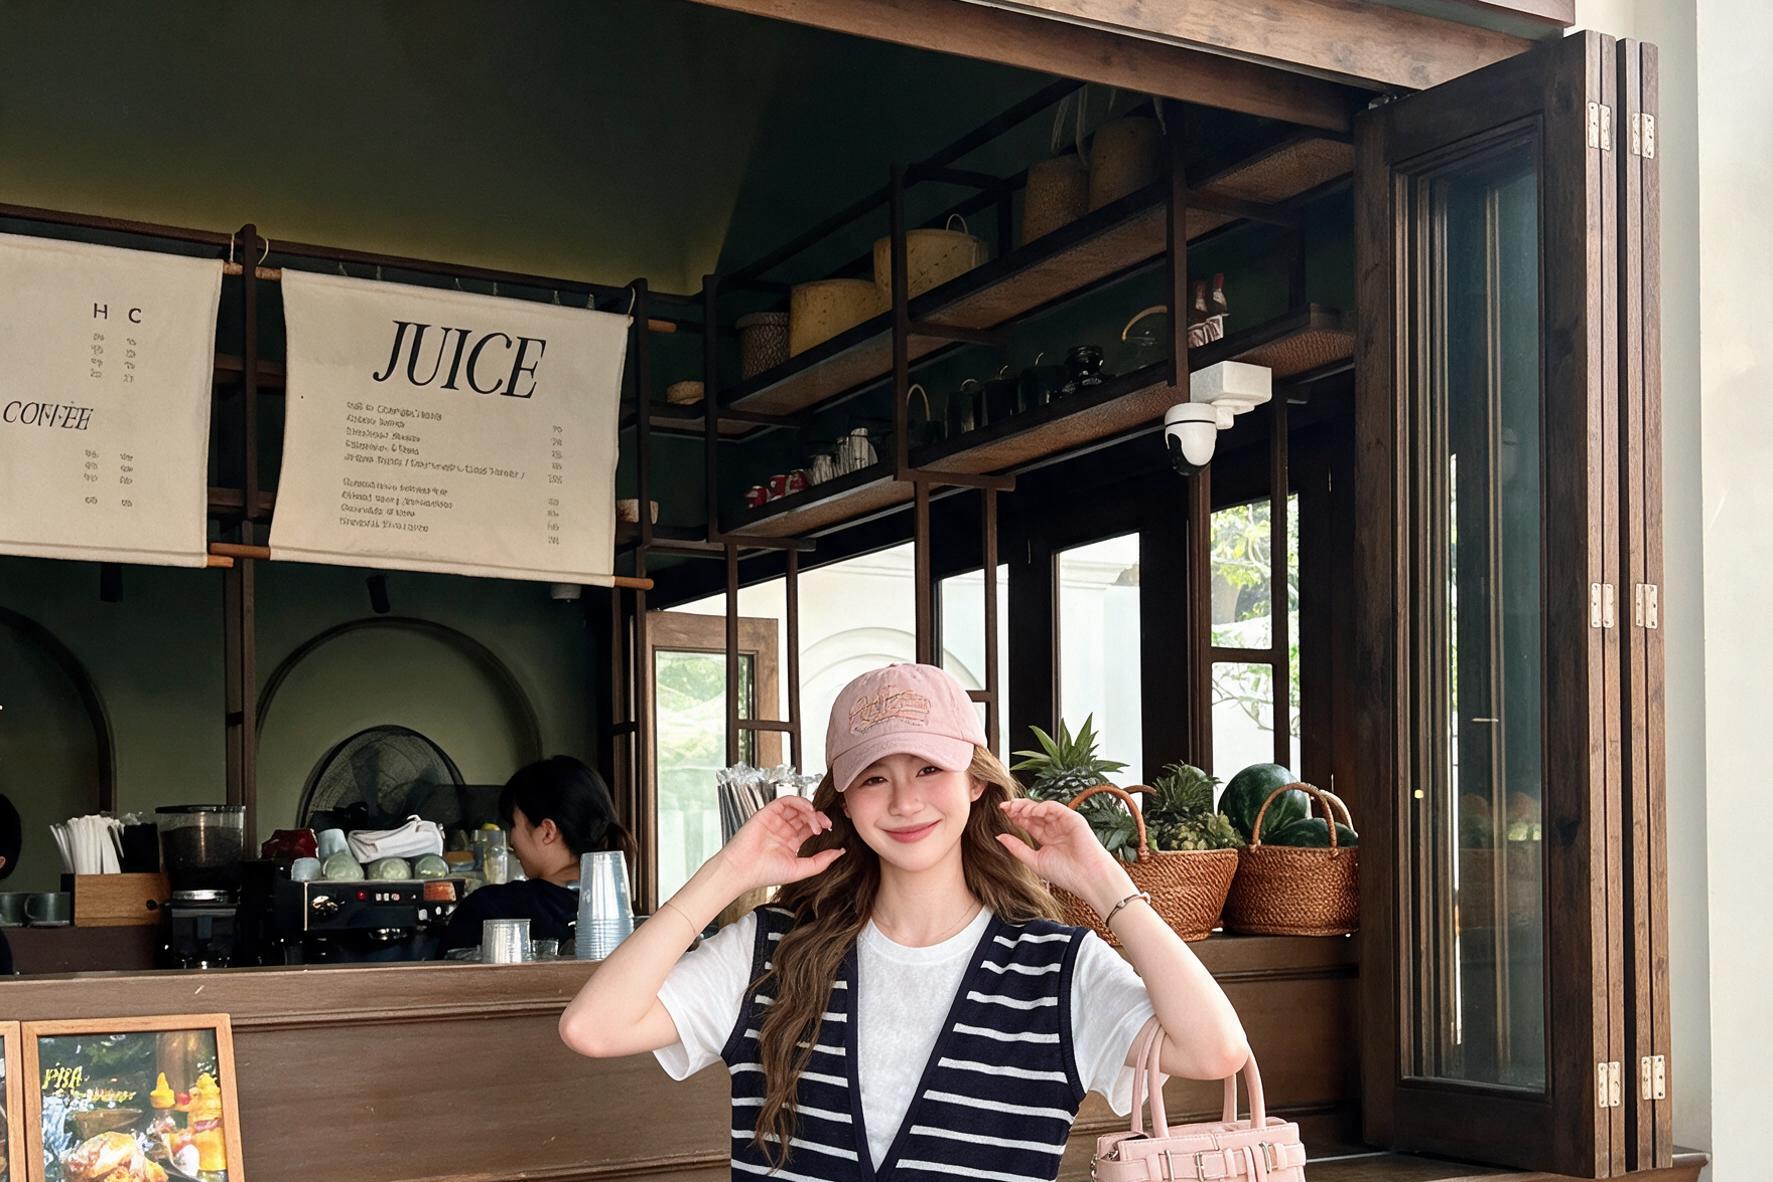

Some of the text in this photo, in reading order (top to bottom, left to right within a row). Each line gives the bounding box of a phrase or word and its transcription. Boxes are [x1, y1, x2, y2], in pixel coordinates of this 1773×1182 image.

[93, 302, 142, 324] H C
[372, 319, 547, 399] JUICE
